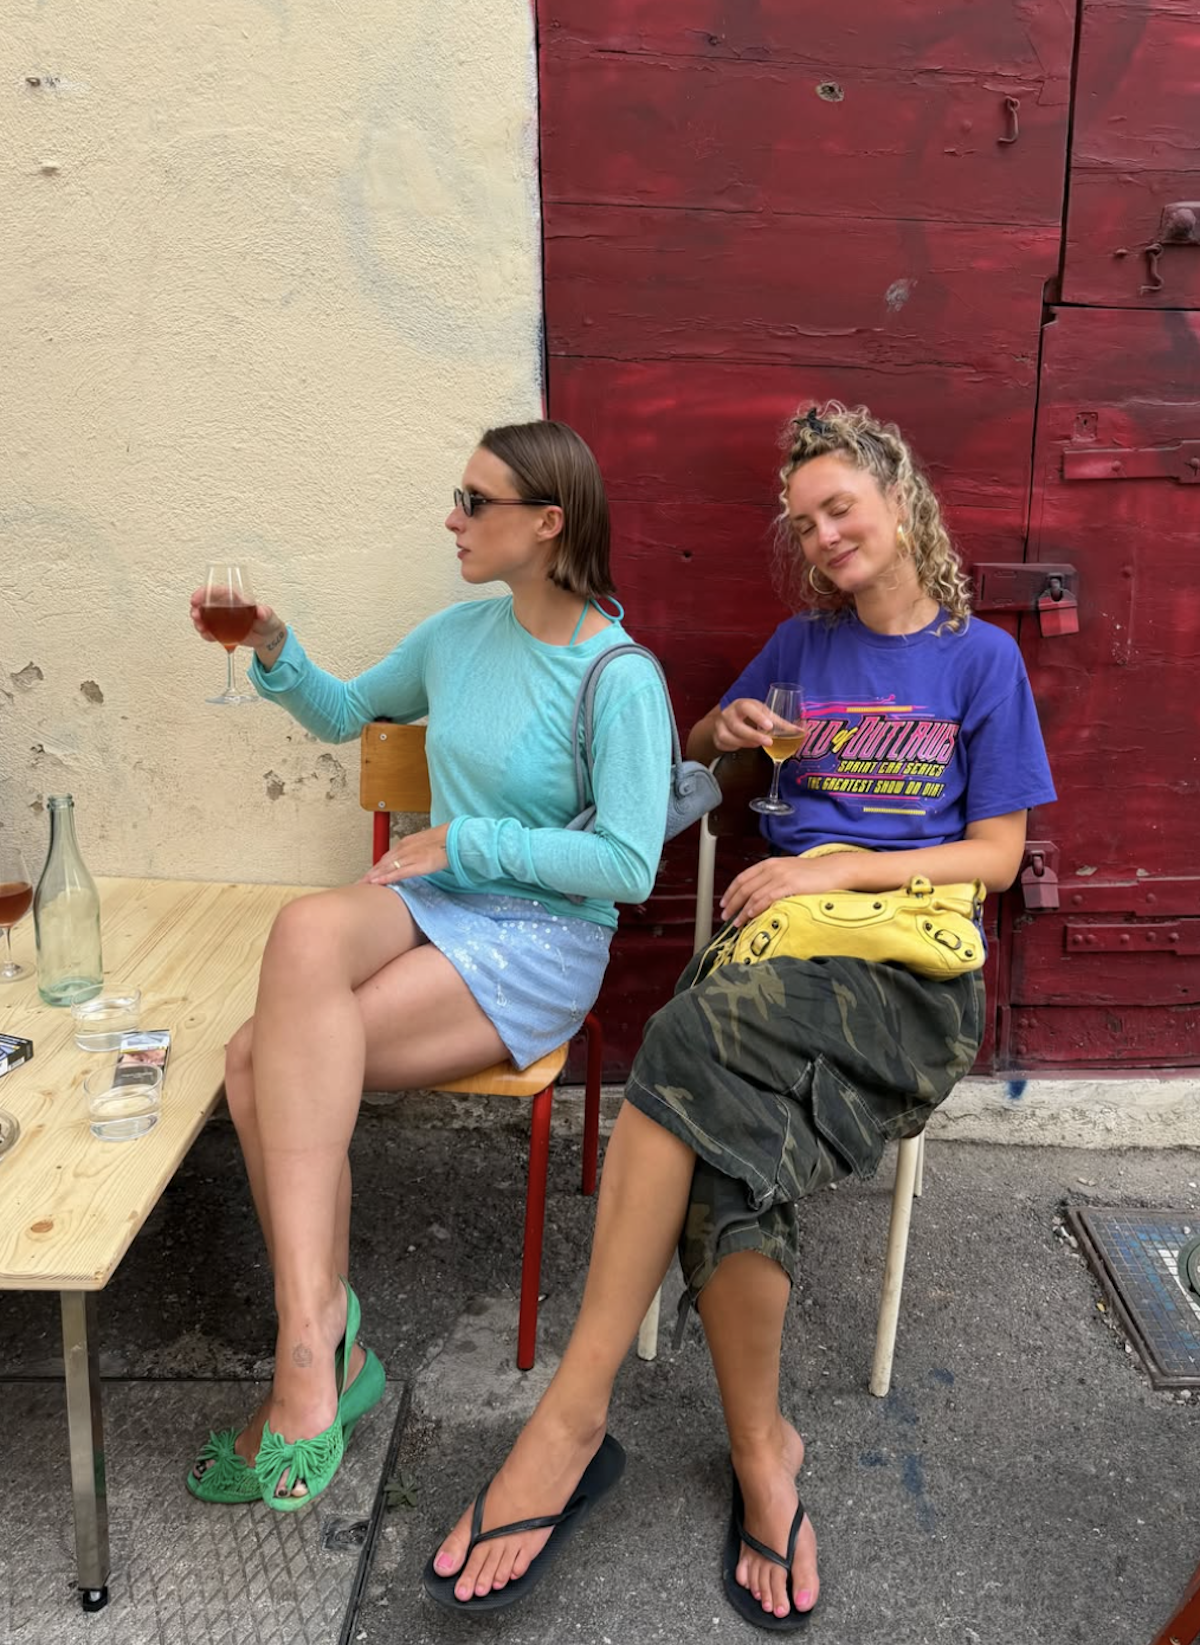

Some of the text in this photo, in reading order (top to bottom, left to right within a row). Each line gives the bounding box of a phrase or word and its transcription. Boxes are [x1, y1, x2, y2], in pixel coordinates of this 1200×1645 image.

[796, 715, 959, 764] RLD of OUTLAWS
[837, 760, 945, 778] SPRINT CAR SERIES
[807, 776, 945, 798] THE GREATEST SHOW ON DIRT
